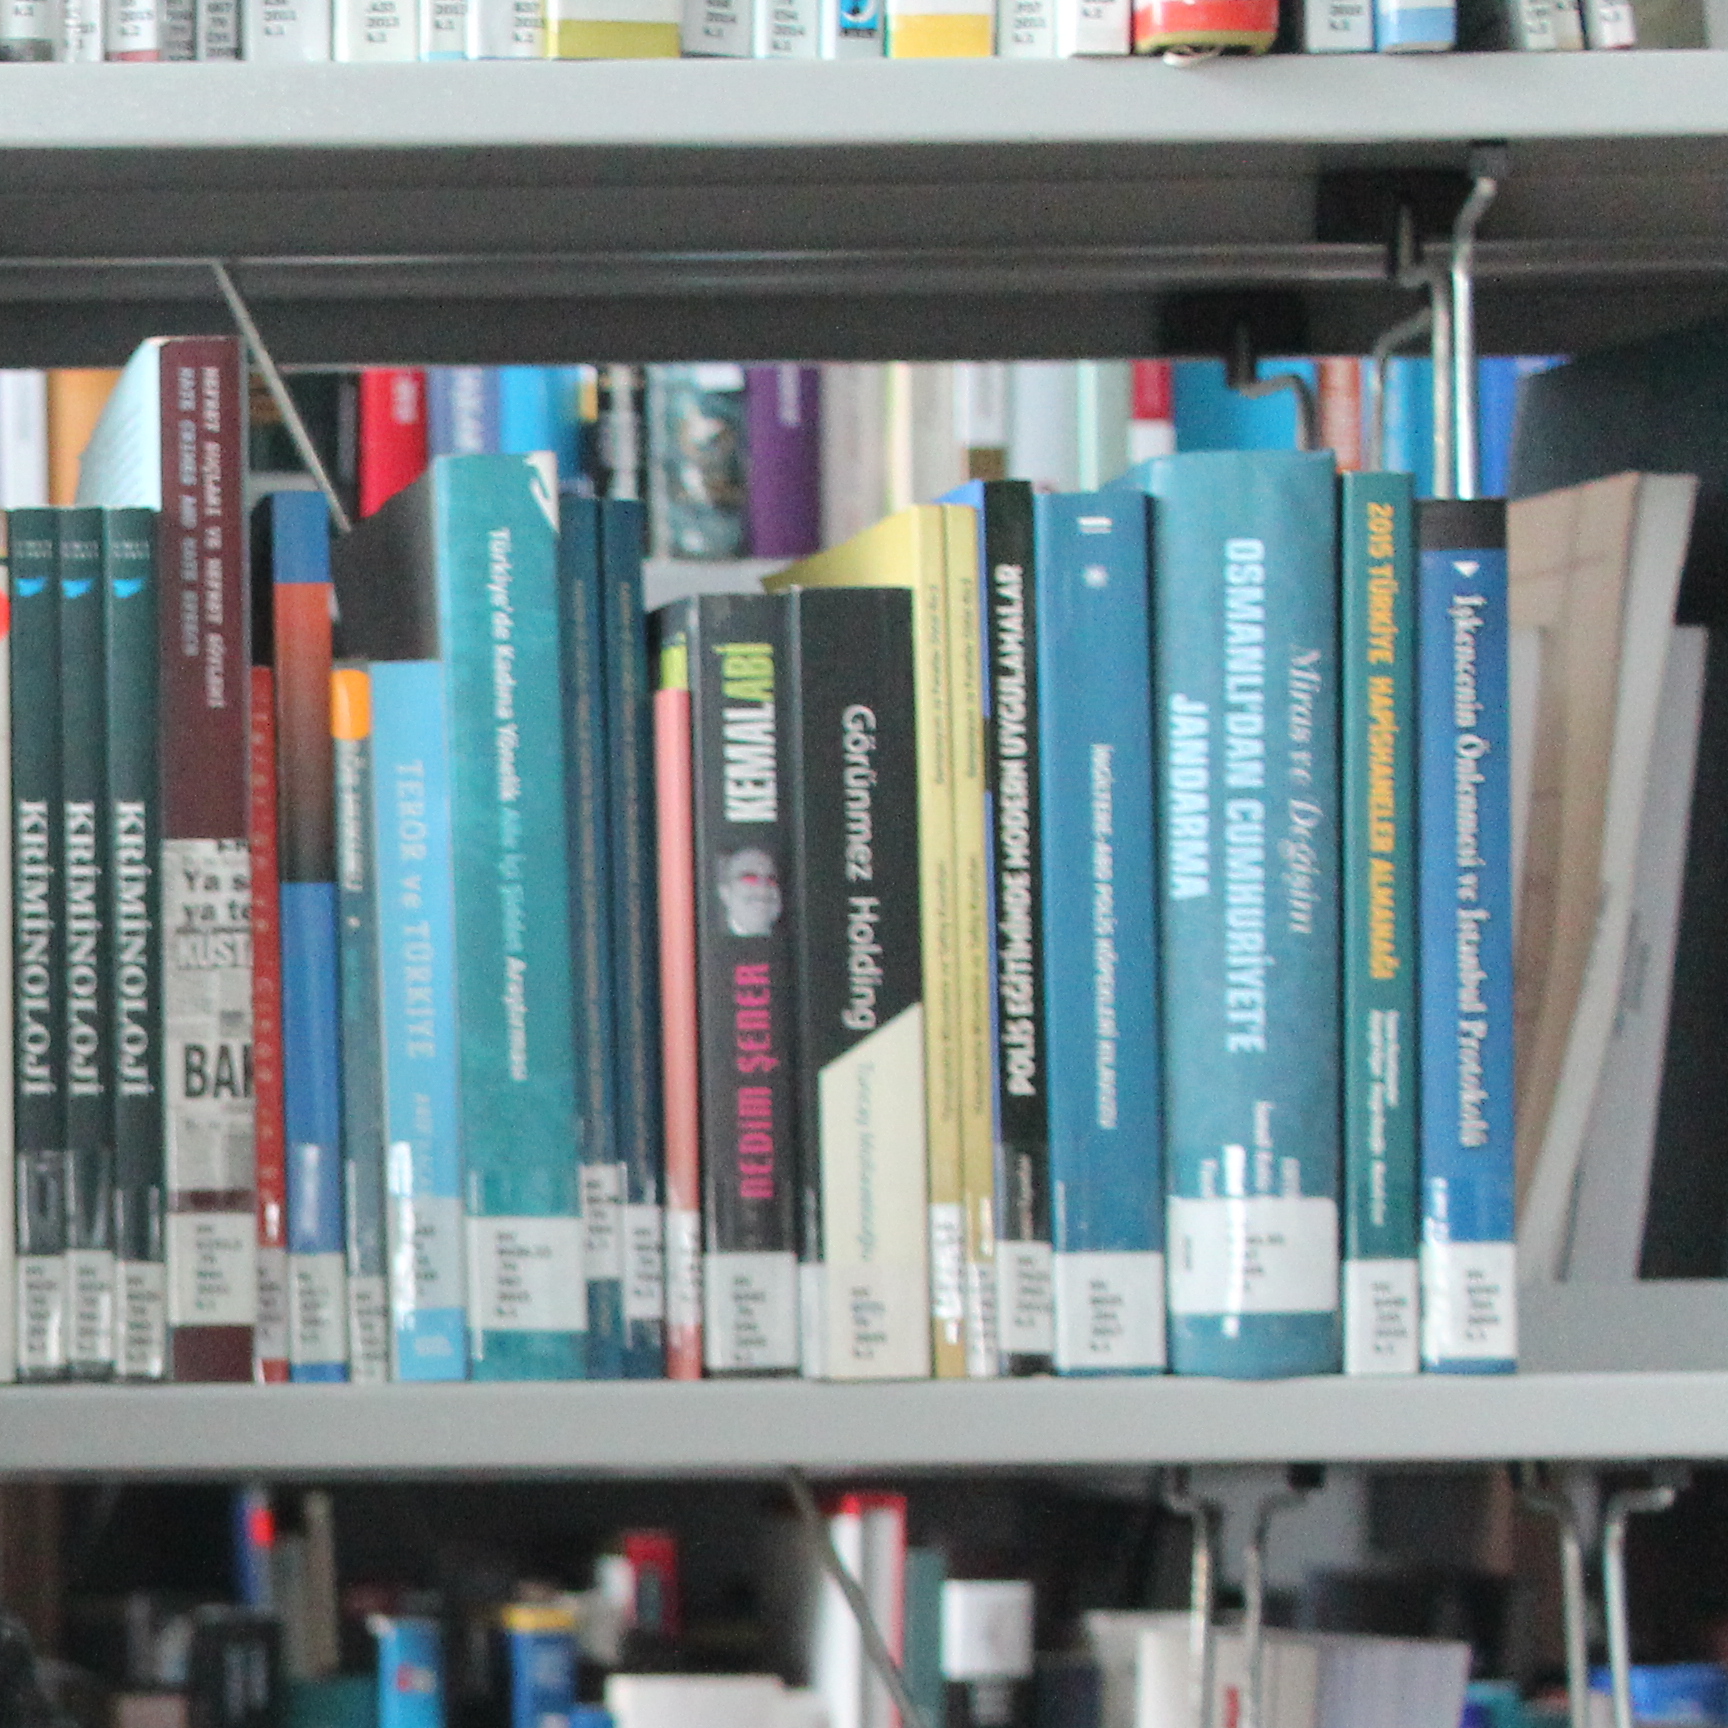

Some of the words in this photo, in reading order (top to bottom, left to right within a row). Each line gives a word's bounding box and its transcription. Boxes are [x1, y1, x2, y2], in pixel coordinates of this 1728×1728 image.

[1223, 537, 1266, 789] OSMANLI'DAN
[1367, 564, 1400, 665] TÜRKİYE
[842, 704, 878, 883] Görünmez
[1167, 693, 1210, 902] JANDARMA
[1368, 676, 1399, 853] HAPİSHANELER
[19, 799, 58, 1097] KRİMİNOLOJİ
[64, 800, 103, 1097] KRİMİNOLOJİ
[115, 800, 154, 1097] KRİMİNOLOJİ
[841, 896, 885, 1031] Holding
[1223, 799, 1276, 1053] CUMHURİYET'E
[1455, 908, 1492, 1013] İstanbul
